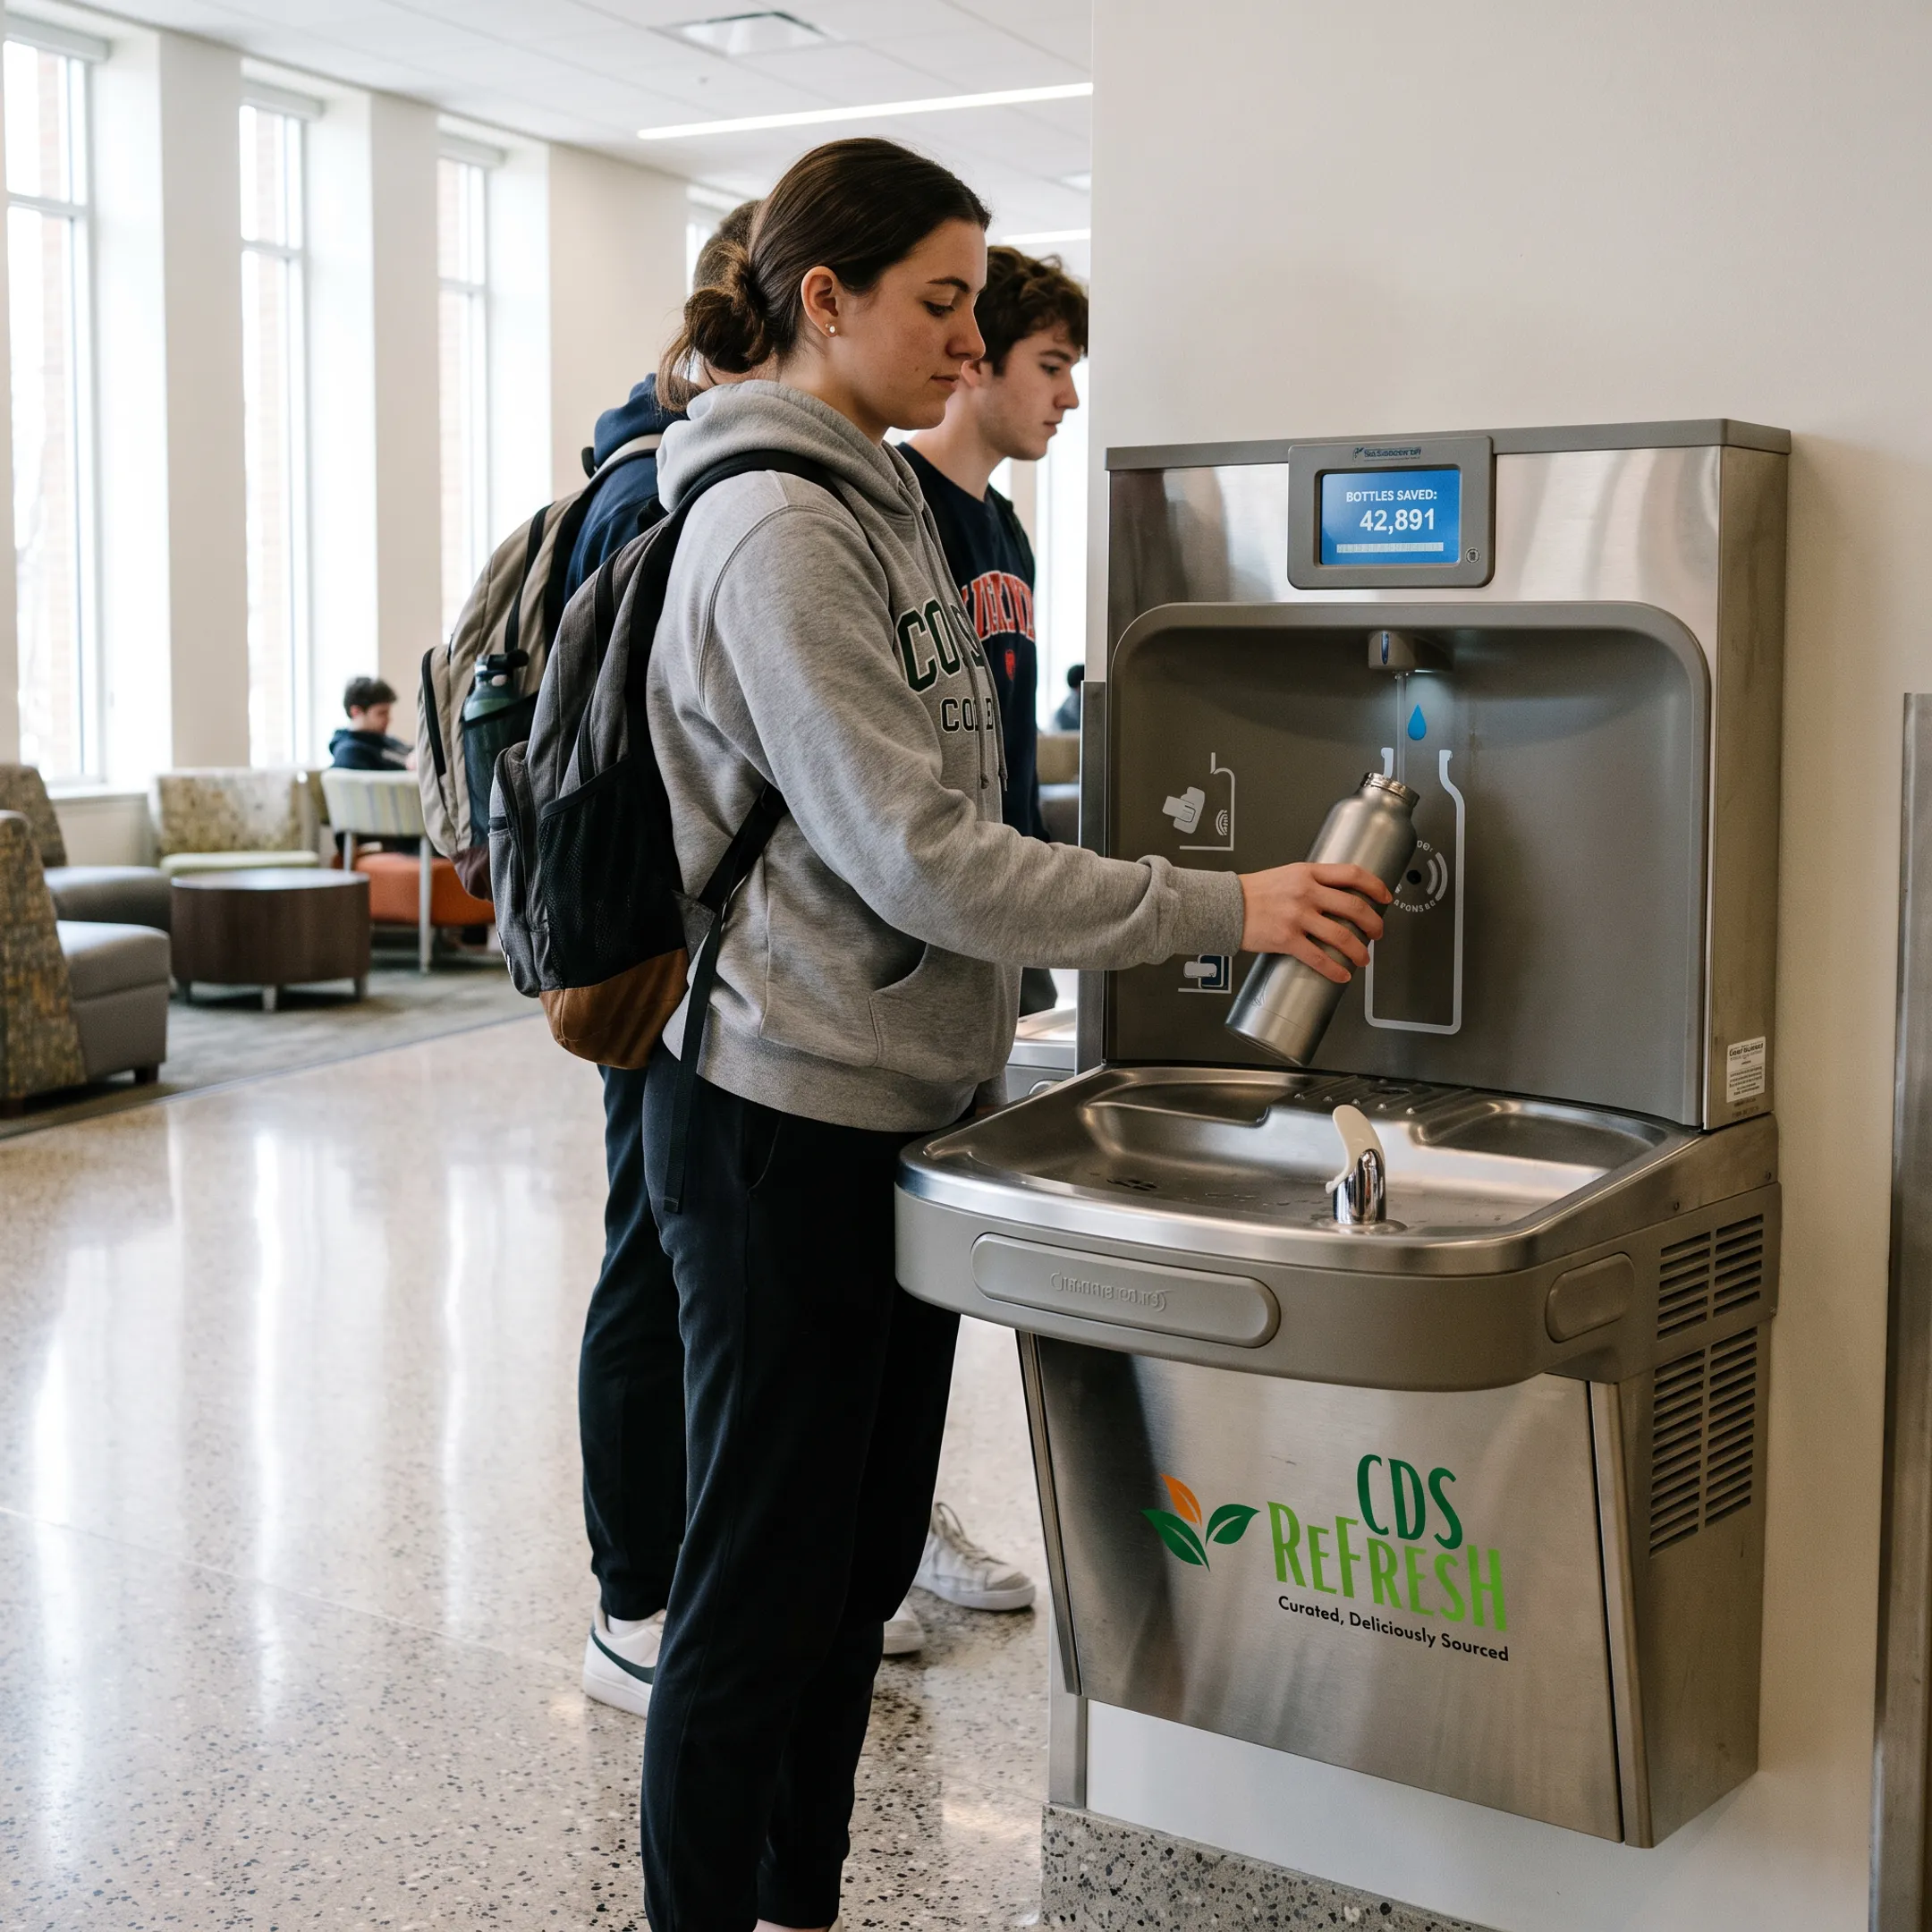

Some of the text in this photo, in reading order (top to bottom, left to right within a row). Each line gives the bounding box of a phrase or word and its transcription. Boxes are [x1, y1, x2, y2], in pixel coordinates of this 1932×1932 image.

[1346, 489, 1437, 503] BOTTLES SAVED:
[1359, 508, 1435, 535] 42,891
[1357, 1453, 1463, 1550] CDS
[1278, 1595, 1510, 1662] Curated, Deliciously Sourced
